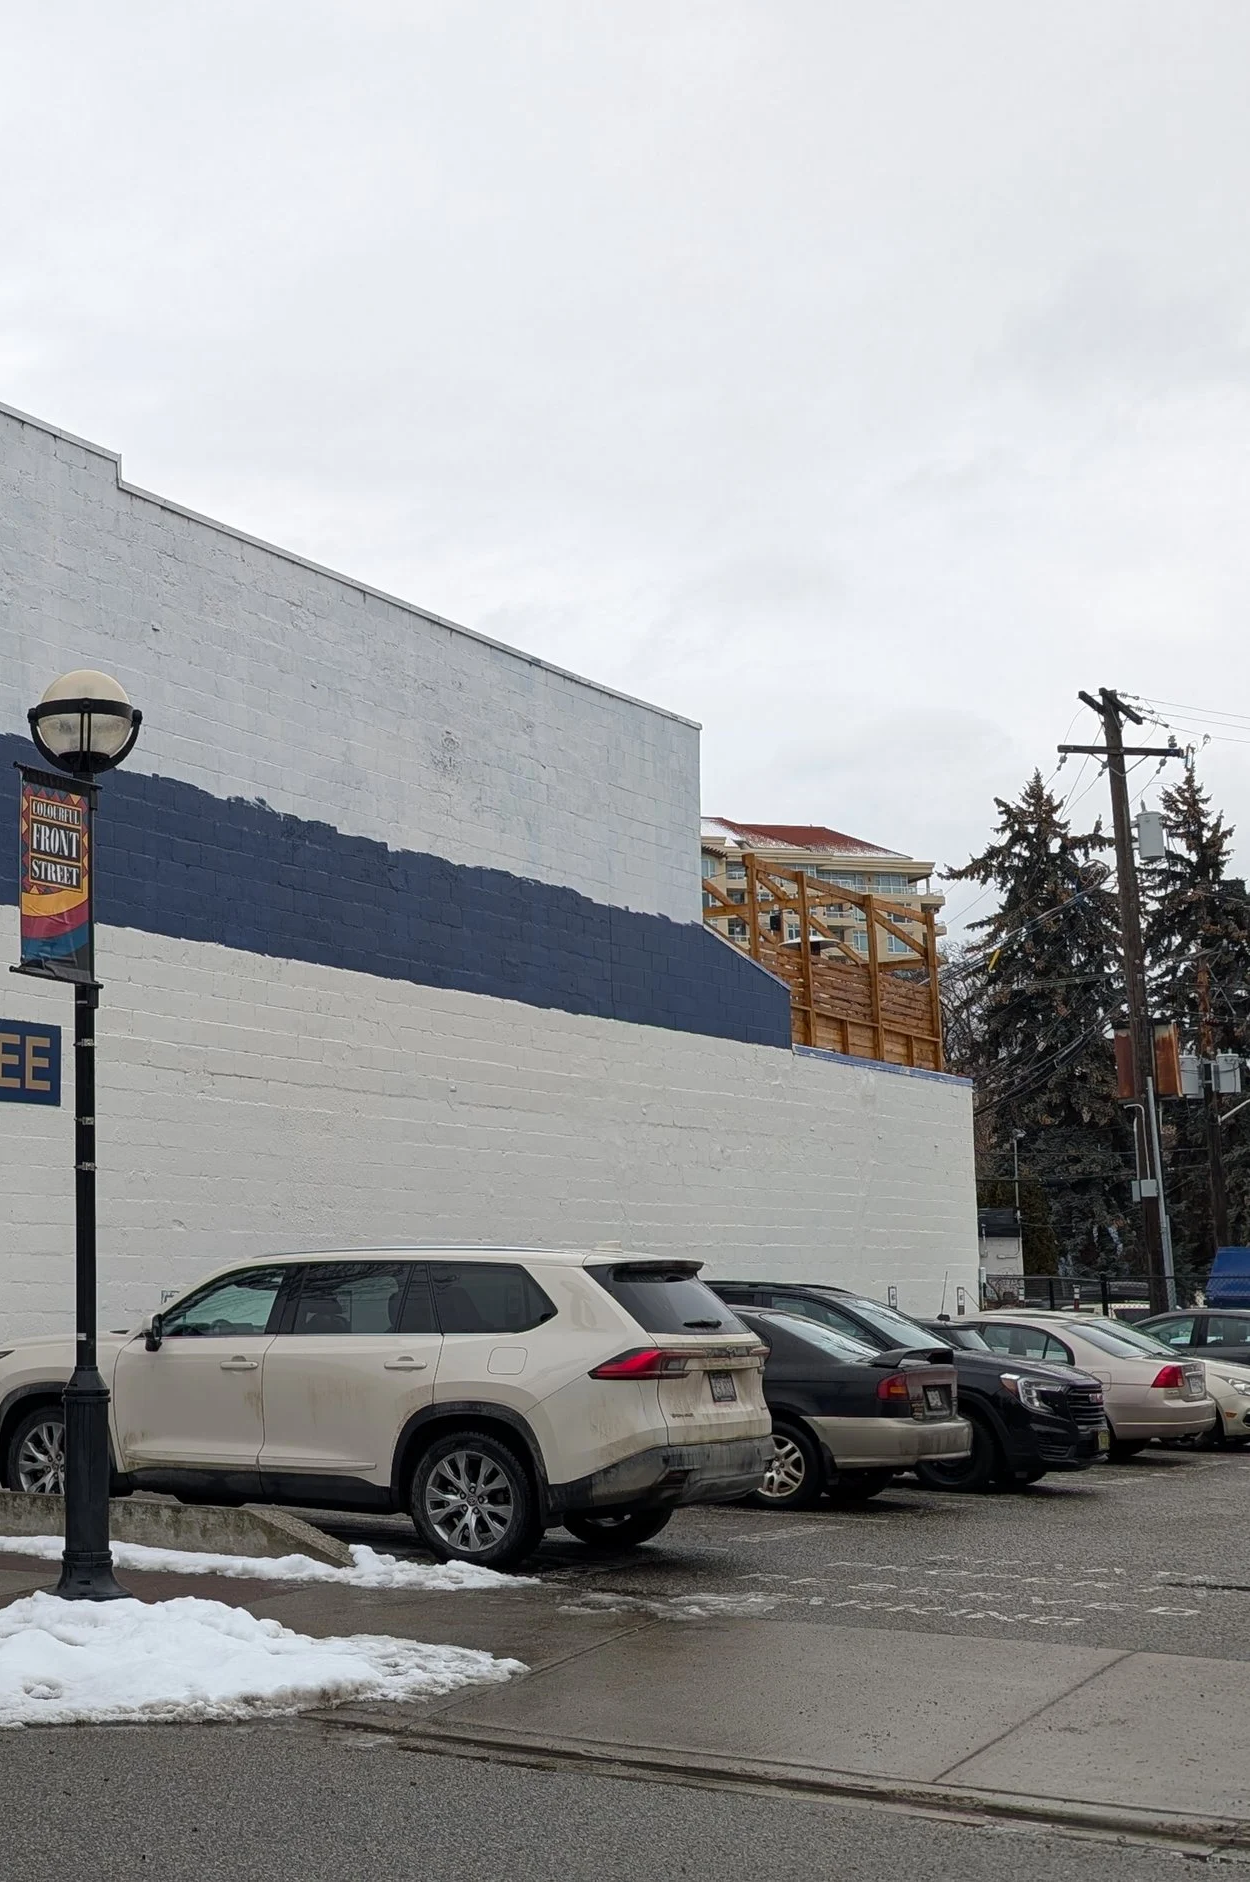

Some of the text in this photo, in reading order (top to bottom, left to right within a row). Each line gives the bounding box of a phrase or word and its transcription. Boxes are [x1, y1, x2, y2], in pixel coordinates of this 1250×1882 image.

[32, 801, 80, 826] COLOURFUL
[32, 822, 80, 860] FRONT
[31, 858, 80, 887] STREET
